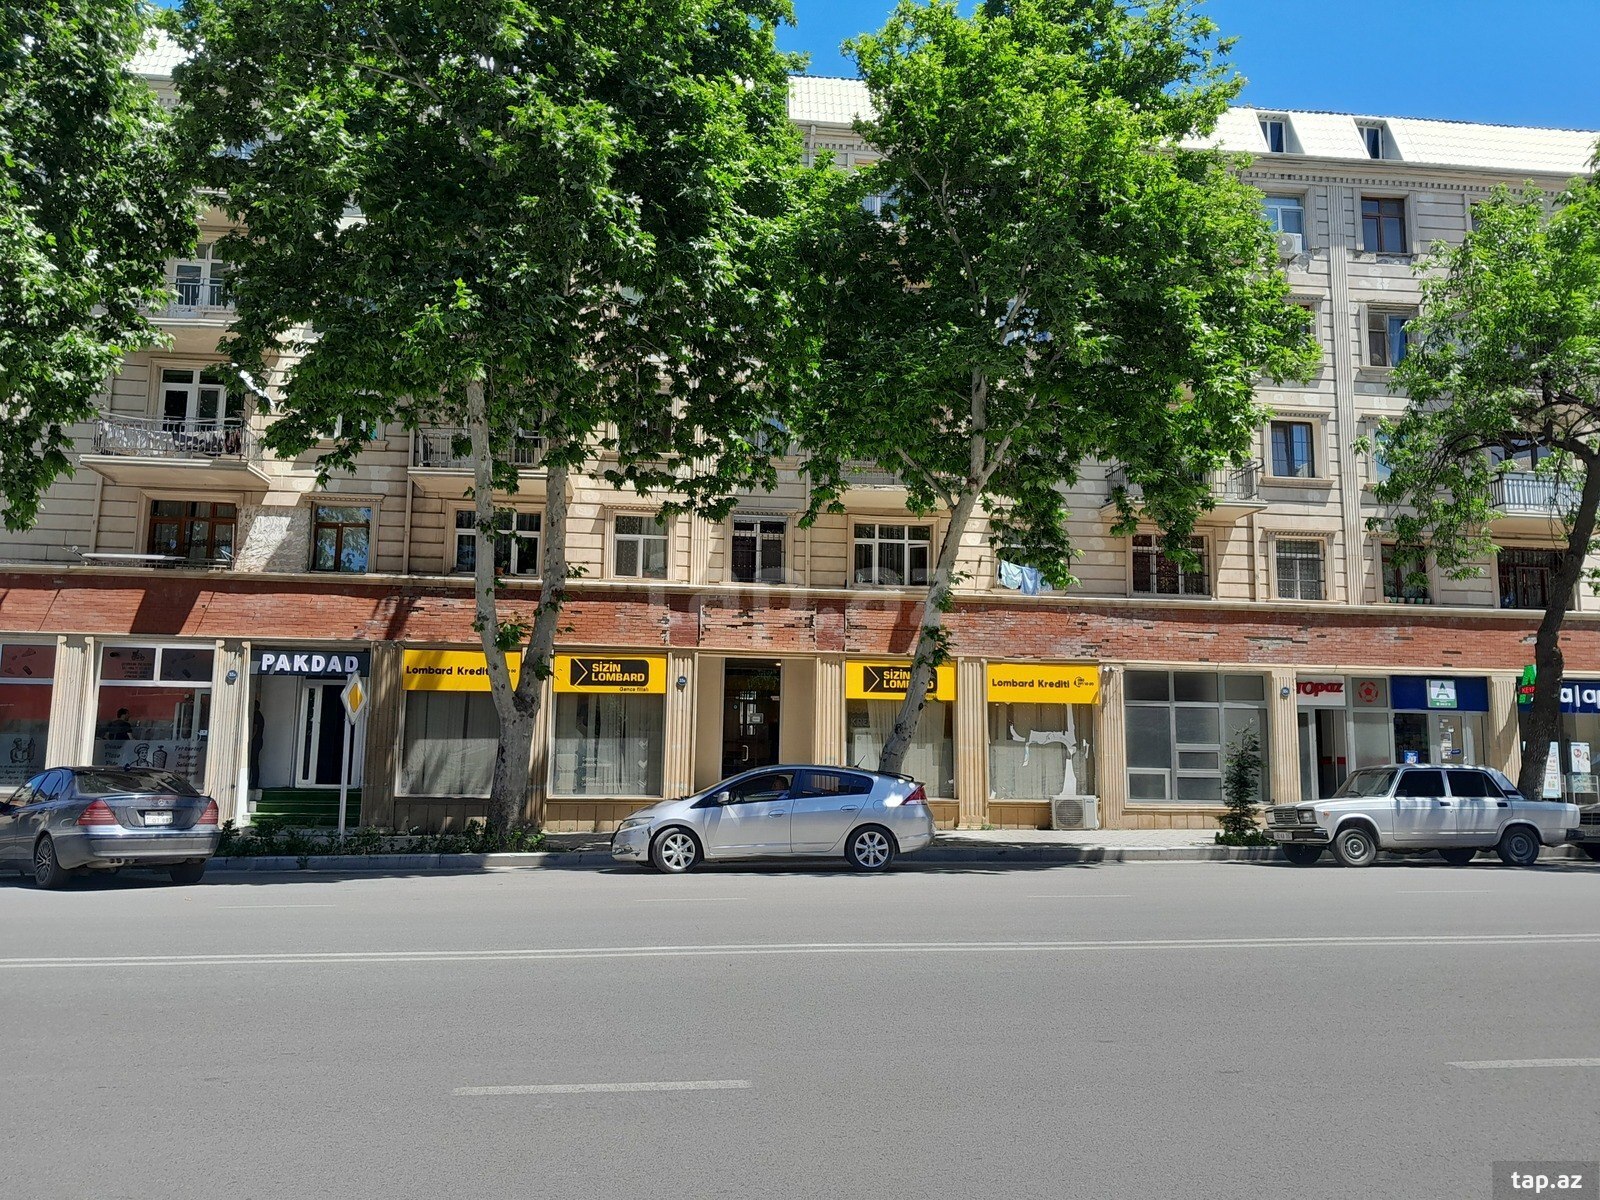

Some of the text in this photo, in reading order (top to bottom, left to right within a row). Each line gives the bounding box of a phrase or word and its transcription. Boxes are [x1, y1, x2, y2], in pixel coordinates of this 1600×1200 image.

[261, 653, 359, 672] PAKDAD
[591, 661, 621, 672] SİZİN
[406, 665, 490, 676] Lombard Kredit
[591, 672, 645, 682] LOMBARD
[992, 678, 1035, 687] Lombard
